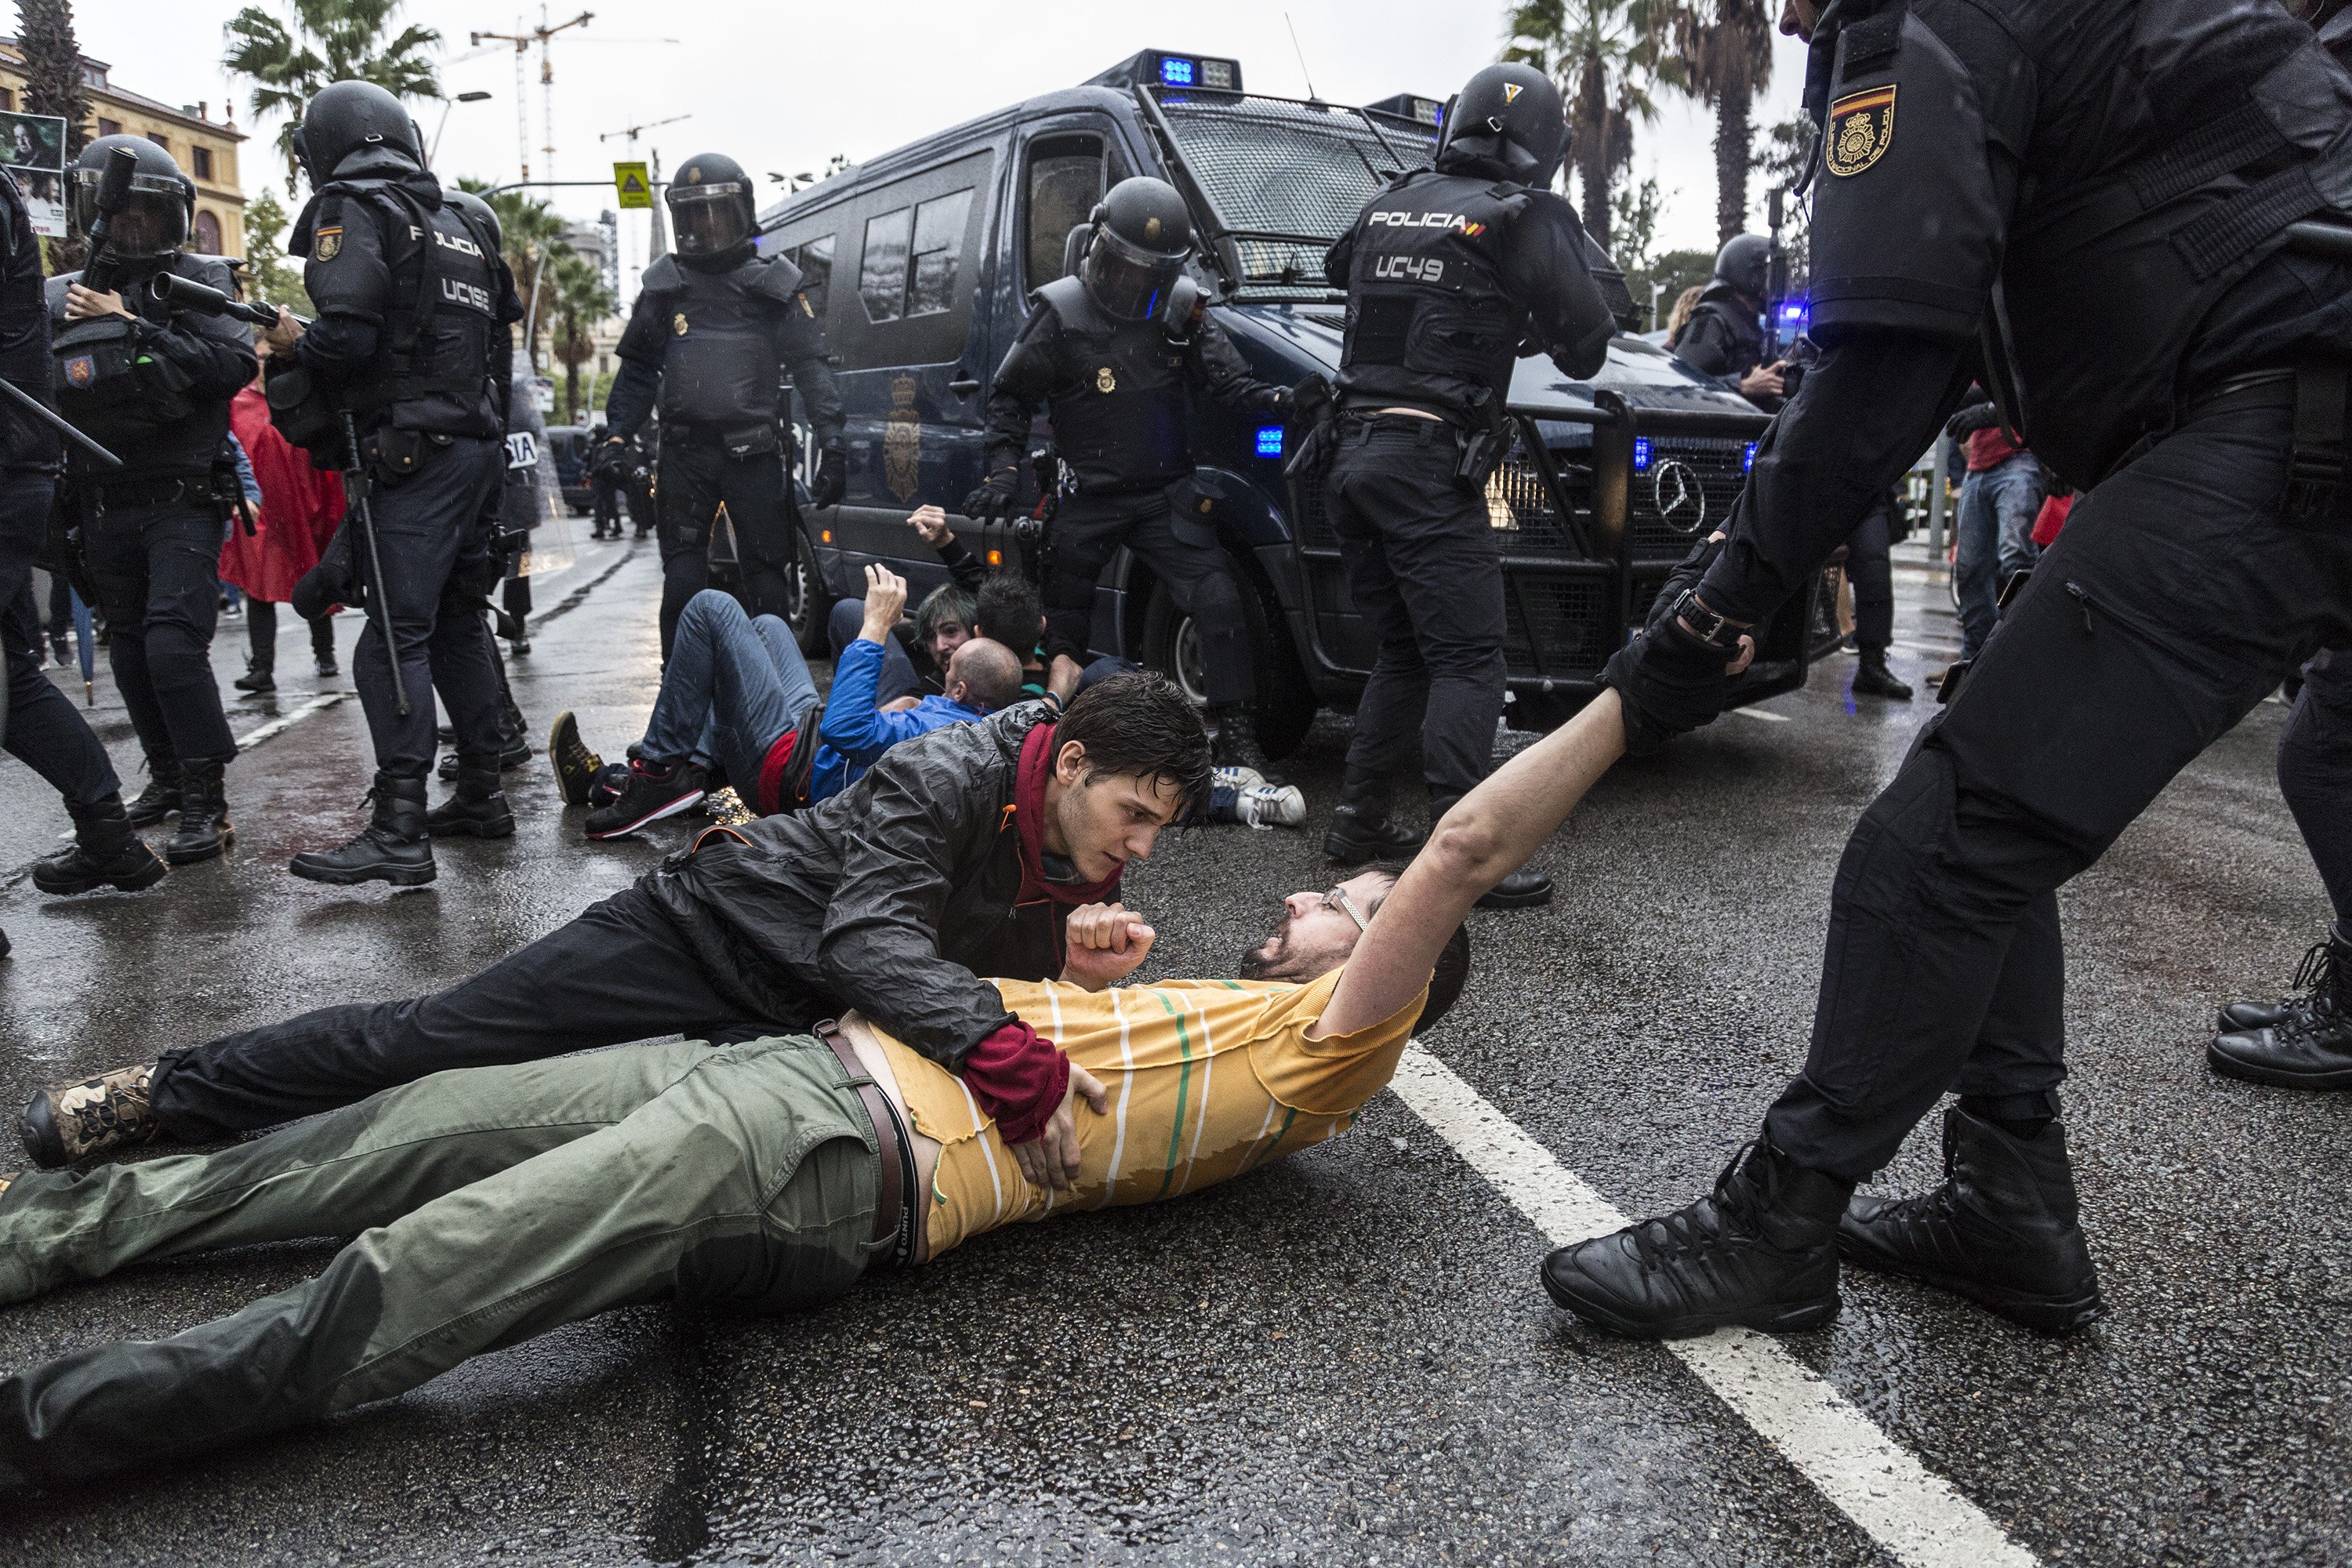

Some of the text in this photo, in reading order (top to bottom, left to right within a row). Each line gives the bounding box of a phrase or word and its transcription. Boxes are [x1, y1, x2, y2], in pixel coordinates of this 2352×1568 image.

[1830, 160, 1868, 172] NACIONAL
[1868, 147, 1882, 161] DE
[1879, 107, 1892, 146] POLICIA
[1369, 212, 1466, 230] POLICIA
[1376, 256, 1444, 282] UC49
